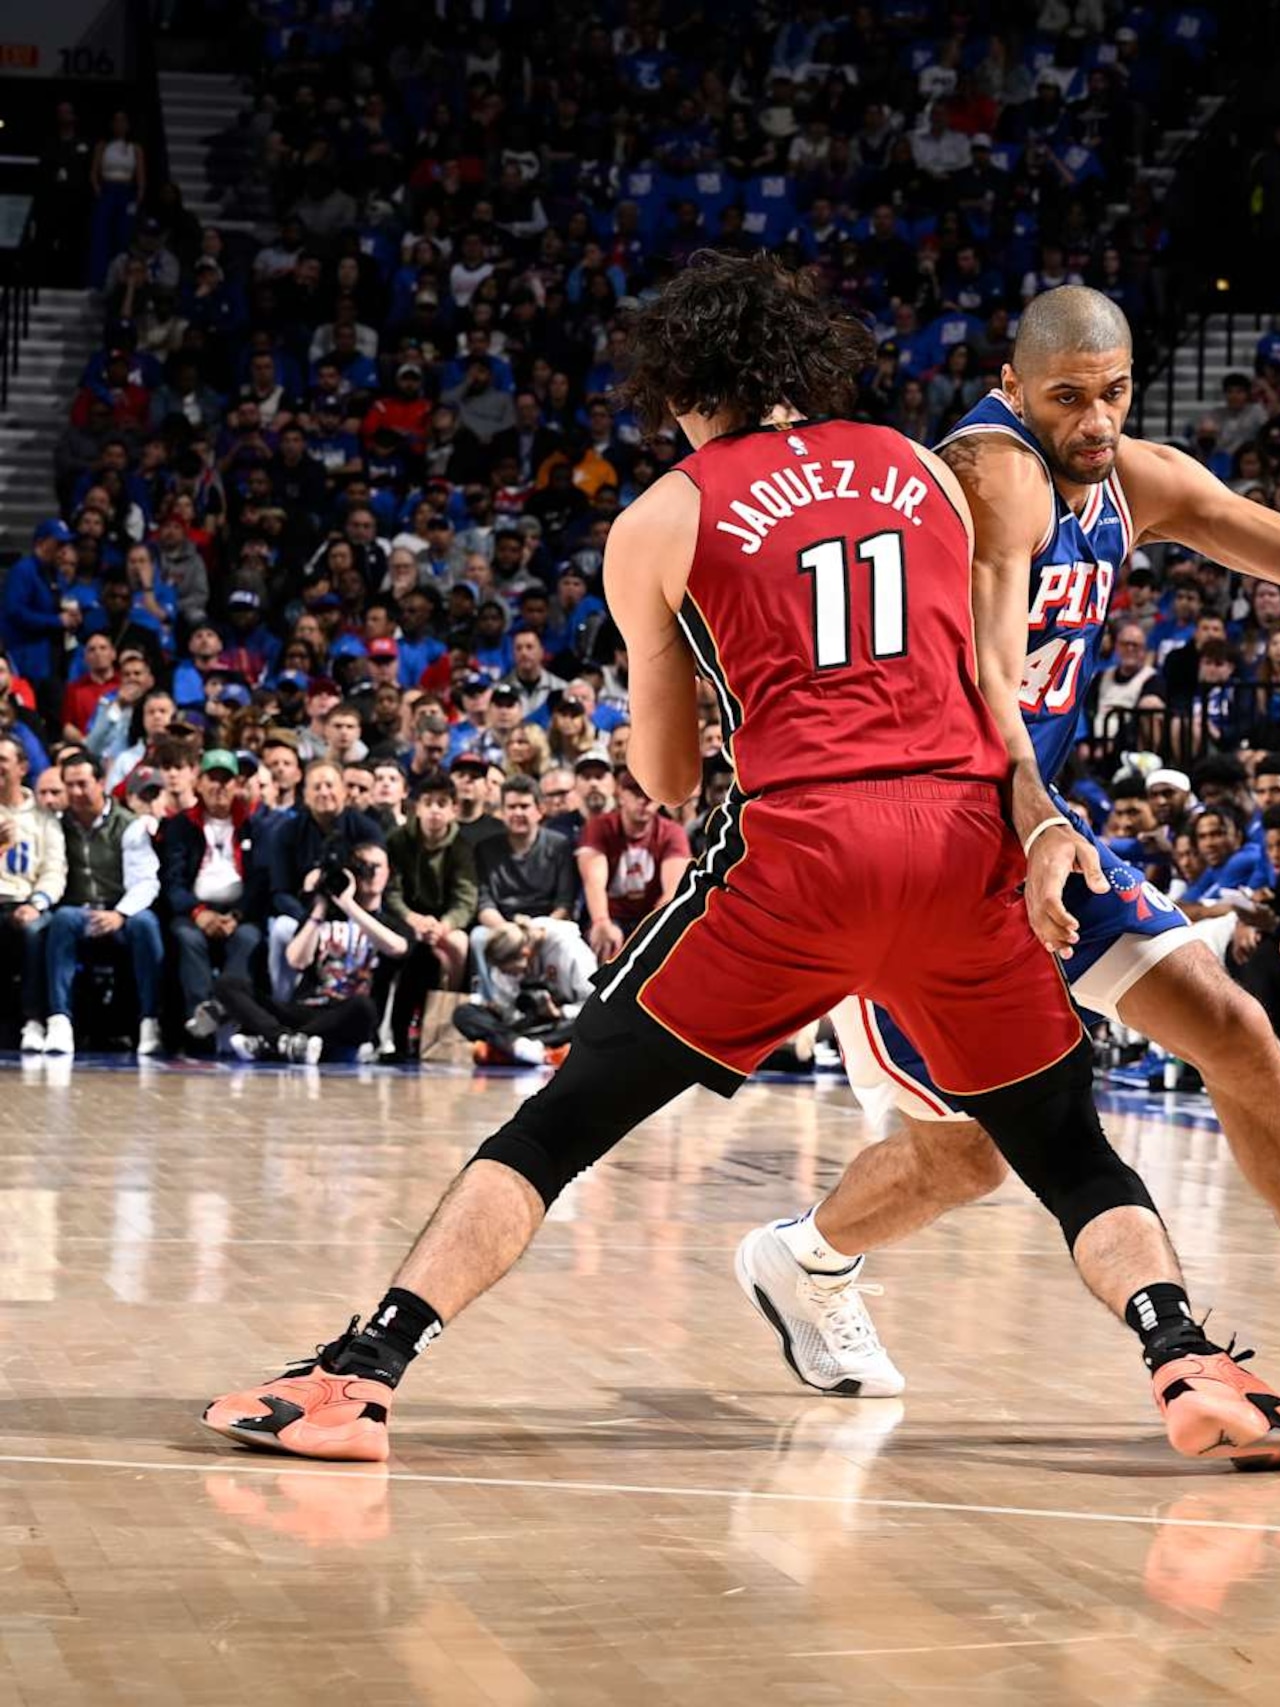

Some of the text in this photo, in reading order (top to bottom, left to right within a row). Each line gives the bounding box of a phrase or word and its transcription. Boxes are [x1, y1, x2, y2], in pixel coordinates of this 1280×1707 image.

[58, 47, 114, 74] 106
[716, 460, 928, 554] JAQUEZ JR.
[797, 529, 908, 671] 11
[1018, 638, 1086, 714] 40
